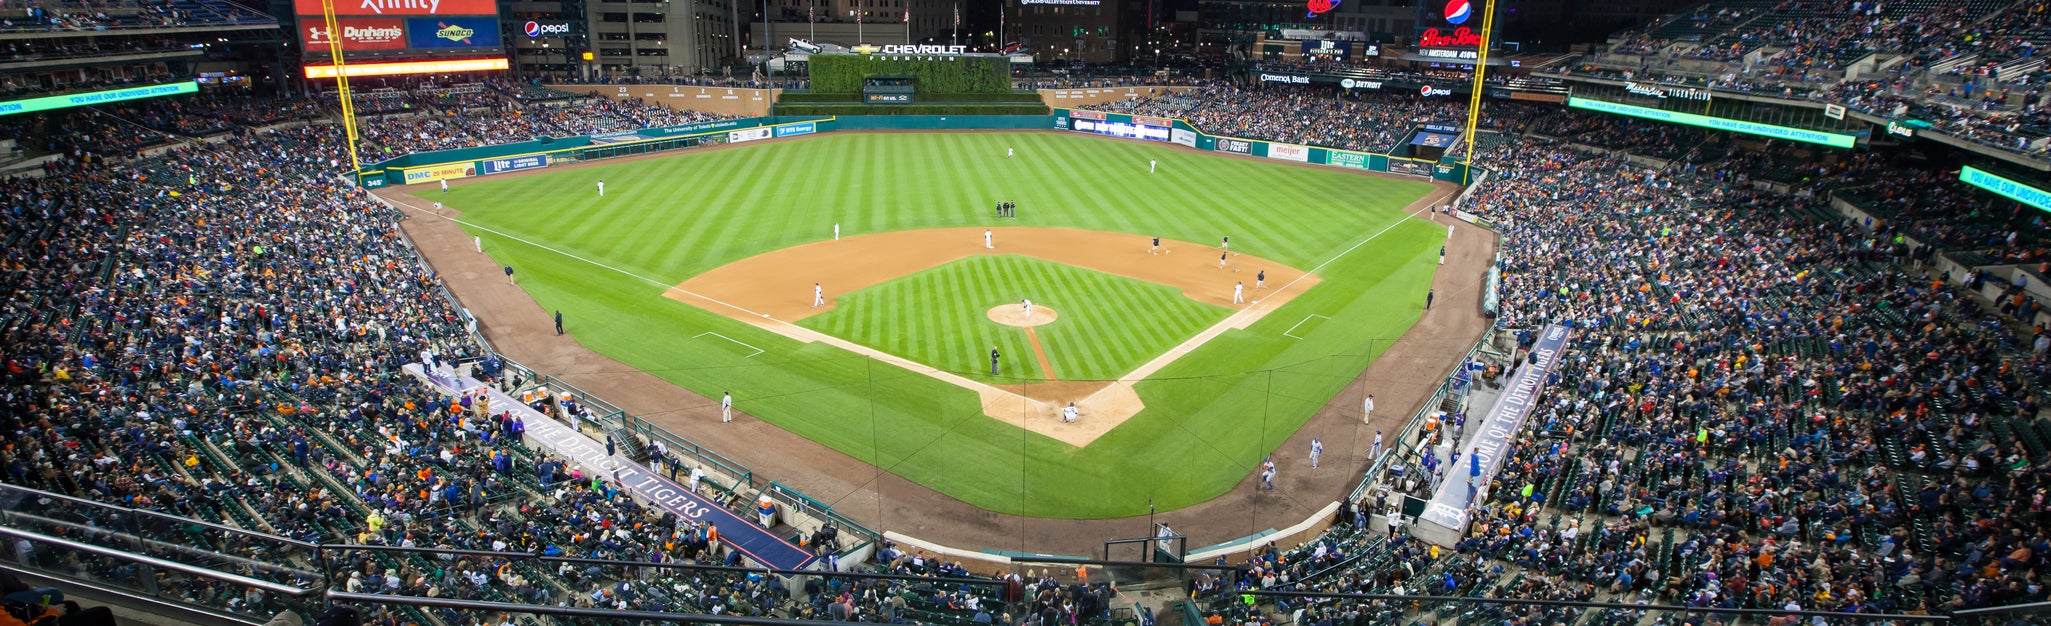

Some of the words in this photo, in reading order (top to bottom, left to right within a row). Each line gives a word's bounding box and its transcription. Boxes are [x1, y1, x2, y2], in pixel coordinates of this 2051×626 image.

[541, 22, 569, 34] pepsi
[885, 44, 966, 54] CHEVROLET
[1356, 80, 1382, 89] DETROIT
[118, 89, 150, 98] UNDIVIDED
[151, 86, 179, 95] ATTENTION
[1432, 88, 1451, 97] pepsi
[1669, 89, 1688, 98] TIGER
[1694, 92, 1711, 100] CLUB
[1617, 106, 1643, 114] UNDIVIDED
[1644, 109, 1671, 118] ATTENTION
[1753, 124, 1788, 136] UNDIVIDED
[1790, 130, 1828, 142] ATTENTION
[1276, 145, 1300, 156] meijer
[1332, 151, 1364, 161] EASTERN
[494, 160, 510, 171] Lite
[408, 171, 431, 180] DMC
[1970, 171, 1983, 183] YOU
[1984, 175, 2000, 190] HAVE
[2001, 182, 2016, 194] OUR
[1496, 406, 1520, 424] THE
[636, 476, 710, 518] TIGERS
